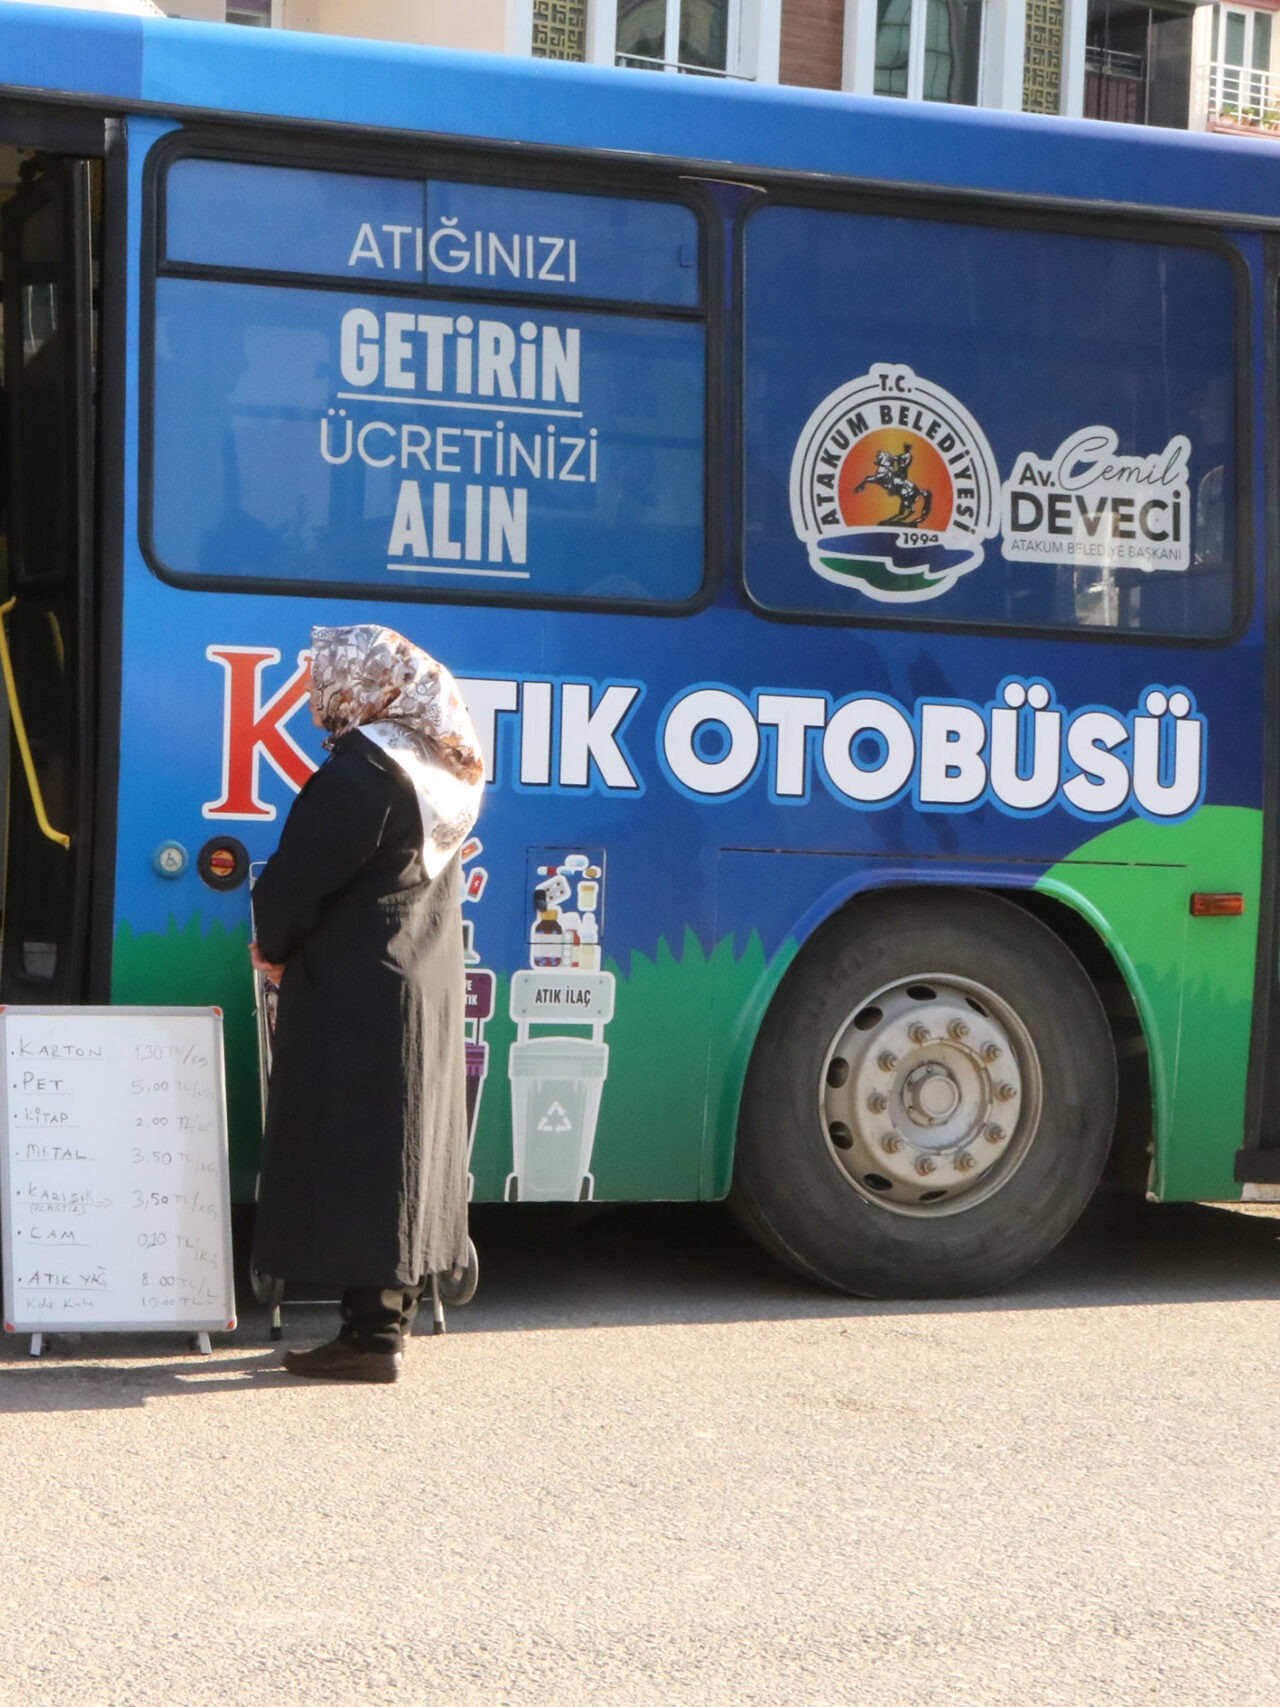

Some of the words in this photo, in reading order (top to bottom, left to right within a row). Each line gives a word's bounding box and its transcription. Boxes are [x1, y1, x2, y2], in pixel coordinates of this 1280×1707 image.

[348, 216, 577, 282] ATIĞINIZI
[878, 373, 913, 393] T.C.
[320, 408, 598, 483] ÜCRETİNİZİ
[816, 412, 869, 526] ATAKUM
[879, 405, 976, 535] BELEDİYESİ
[1018, 462, 1056, 488] Av.
[1058, 436, 1182, 491] Cemil
[387, 480, 527, 563] ALIN
[1010, 490, 1182, 542] DEVECİ
[902, 532, 939, 545] 1994
[1011, 539, 1063, 553] ATAKUM
[1067, 542, 1125, 558] BELEDYE
[1129, 545, 1182, 563] BAŞKANI
[663, 682, 1202, 816] OTOBÜSÜ
[535, 988, 561, 1004] ATIK
[566, 985, 591, 1008] İLAÇ
[19, 1035, 102, 1058] KARTON
[22, 1071, 64, 1091] PET
[26, 1143, 88, 1160] METAL
[30, 1227, 76, 1241] CAM
[28, 1270, 72, 1286] ATIK
